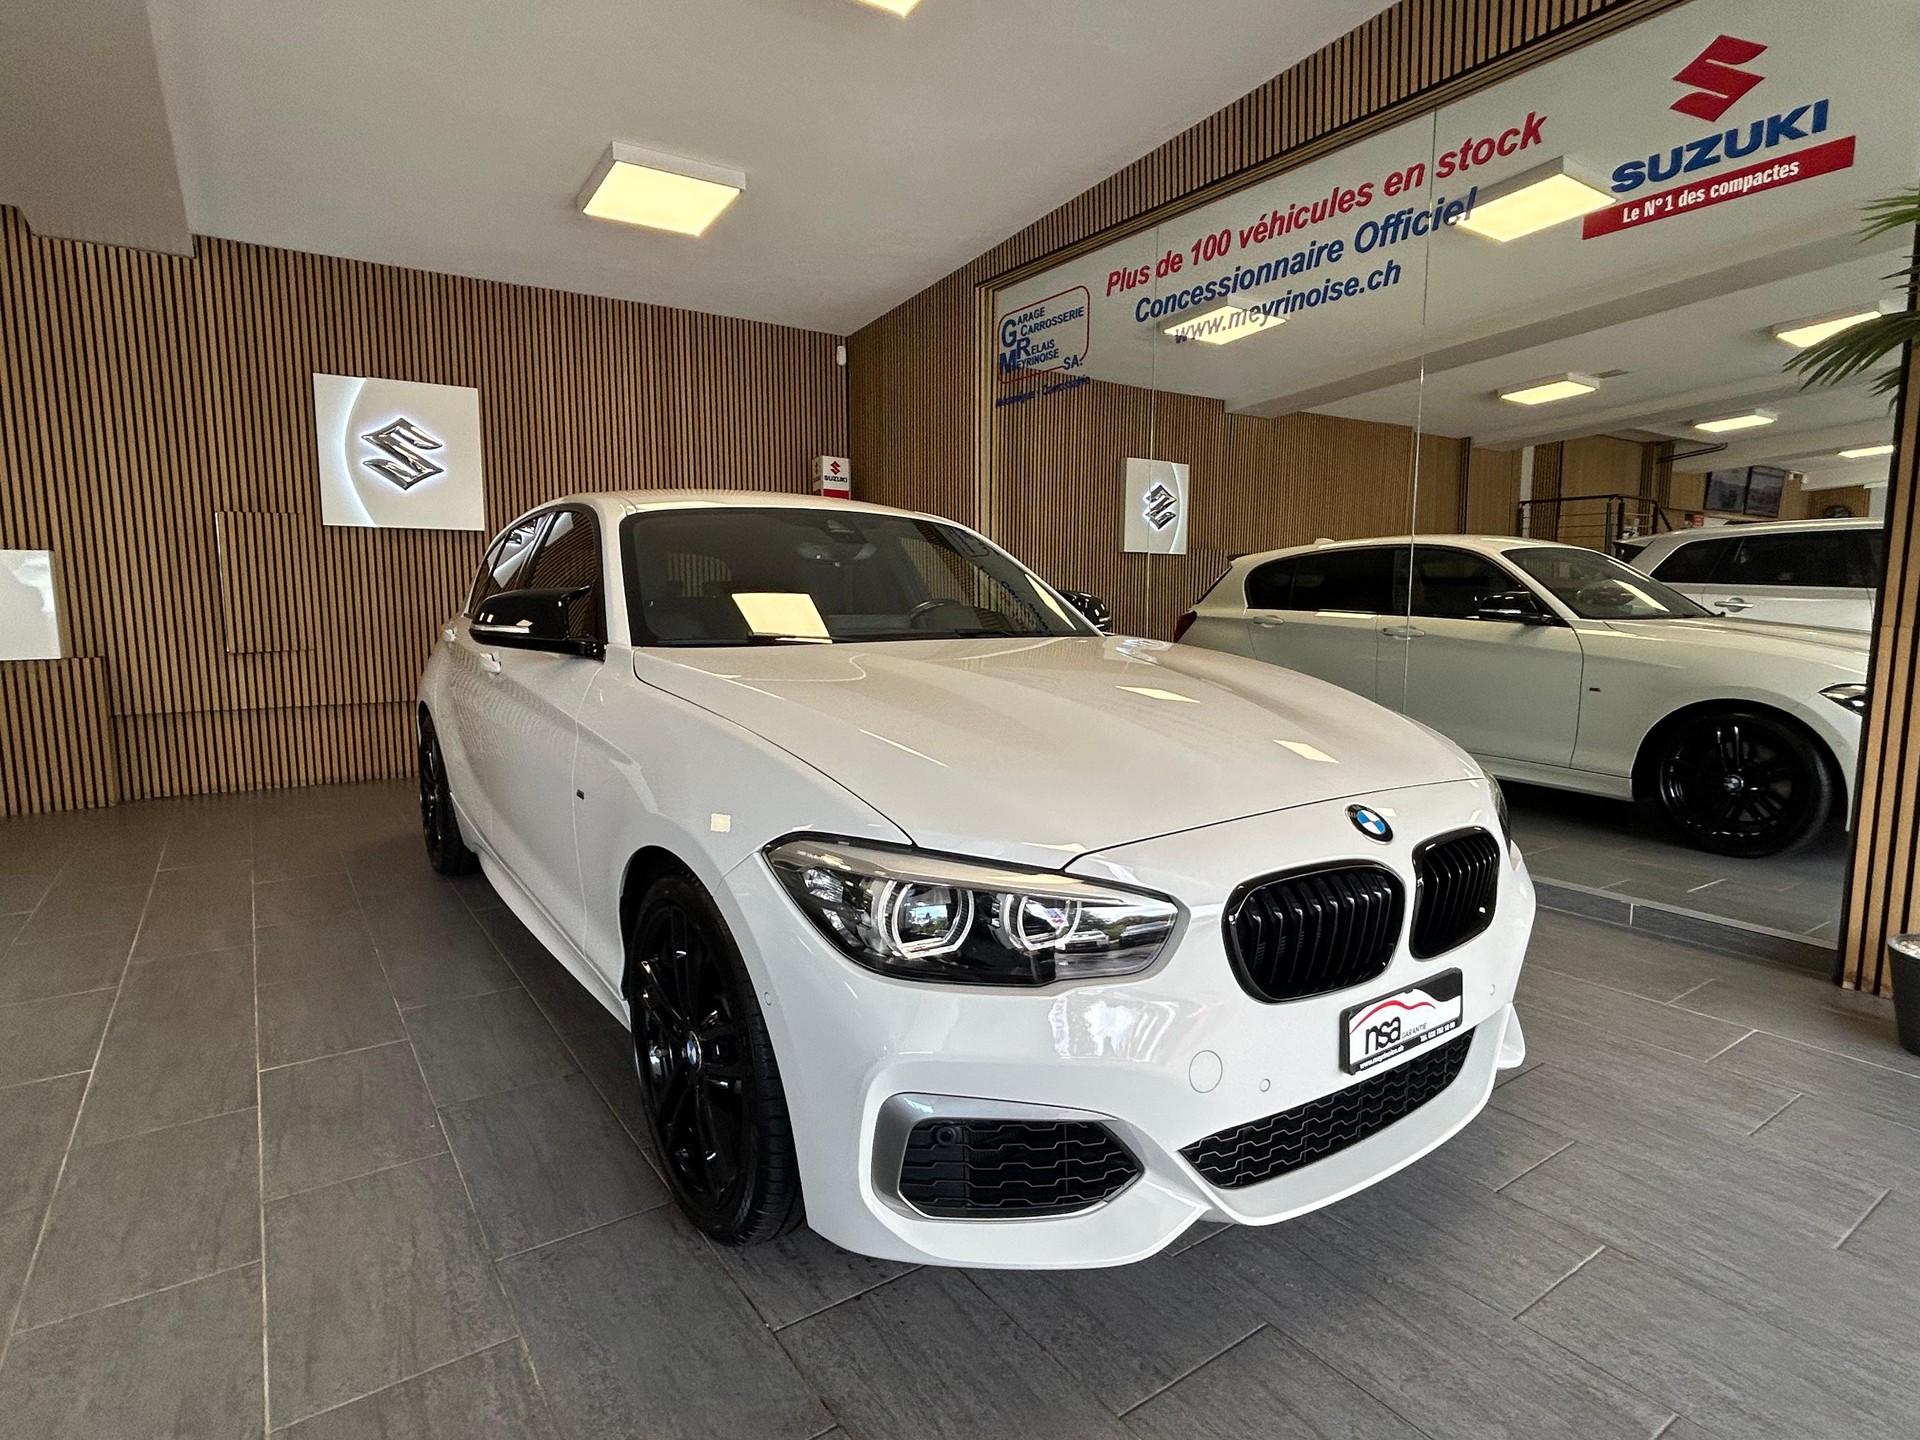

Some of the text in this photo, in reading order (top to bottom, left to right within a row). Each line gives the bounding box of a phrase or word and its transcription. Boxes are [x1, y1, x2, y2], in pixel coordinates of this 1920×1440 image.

[1611, 99, 1829, 193] SUZUKI
[1106, 111, 1547, 296] Plus de 100 véhicules en stock
[1623, 204, 1639, 223] Le
[1678, 186, 1705, 208] des
[1710, 161, 1799, 199] compactes
[1135, 186, 1478, 323] Concessionnaire Officiel
[1020, 306, 1084, 337] CARROSSERIE
[1175, 259, 1402, 345] www.meyrinoise.ch
[1365, 1016, 1401, 1055] nsa
